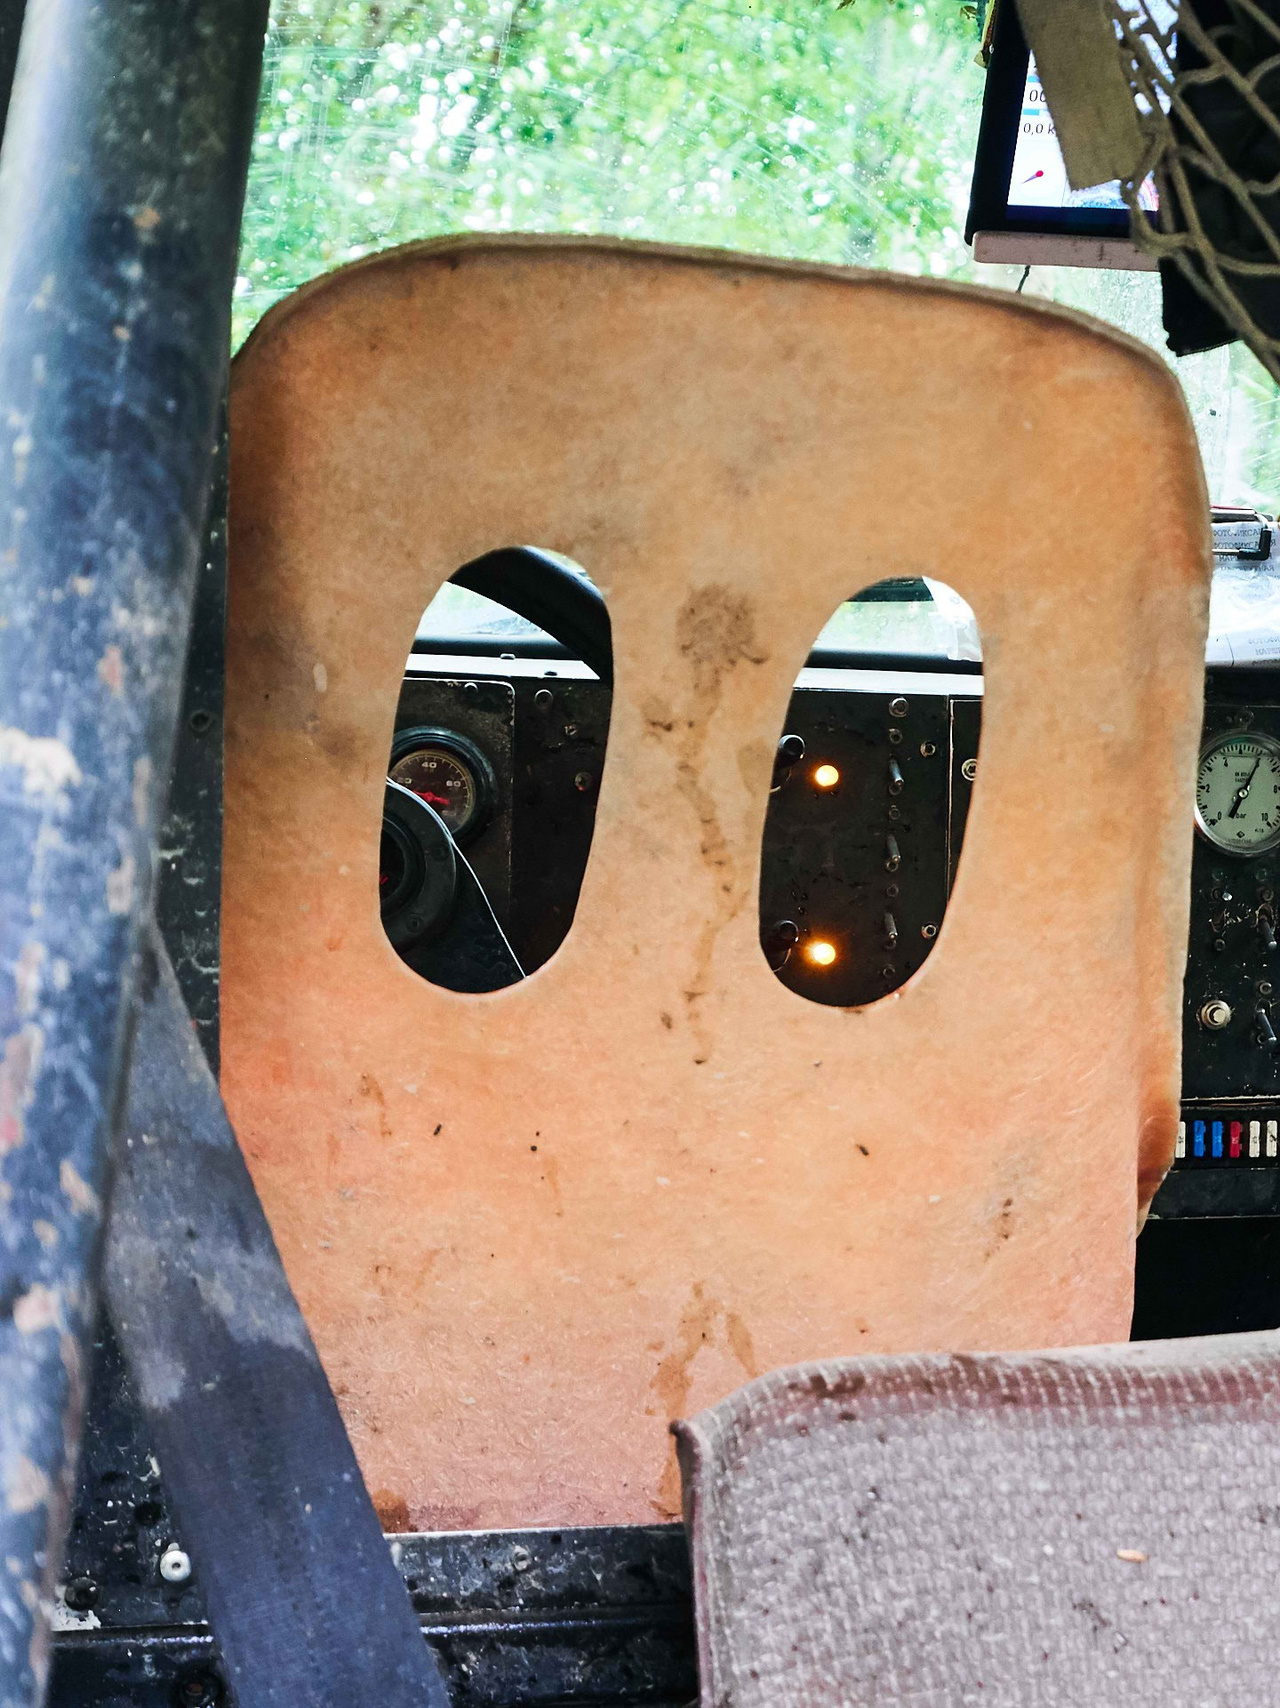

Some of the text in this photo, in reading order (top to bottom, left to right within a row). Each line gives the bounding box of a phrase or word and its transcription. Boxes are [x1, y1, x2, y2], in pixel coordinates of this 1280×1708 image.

[1023, 122, 1044, 136] 0,0
[421, 761, 438, 769] 40
[1205, 783, 1211, 793] 2
[1217, 811, 1222, 821] 0
[1261, 813, 1269, 822] 10
